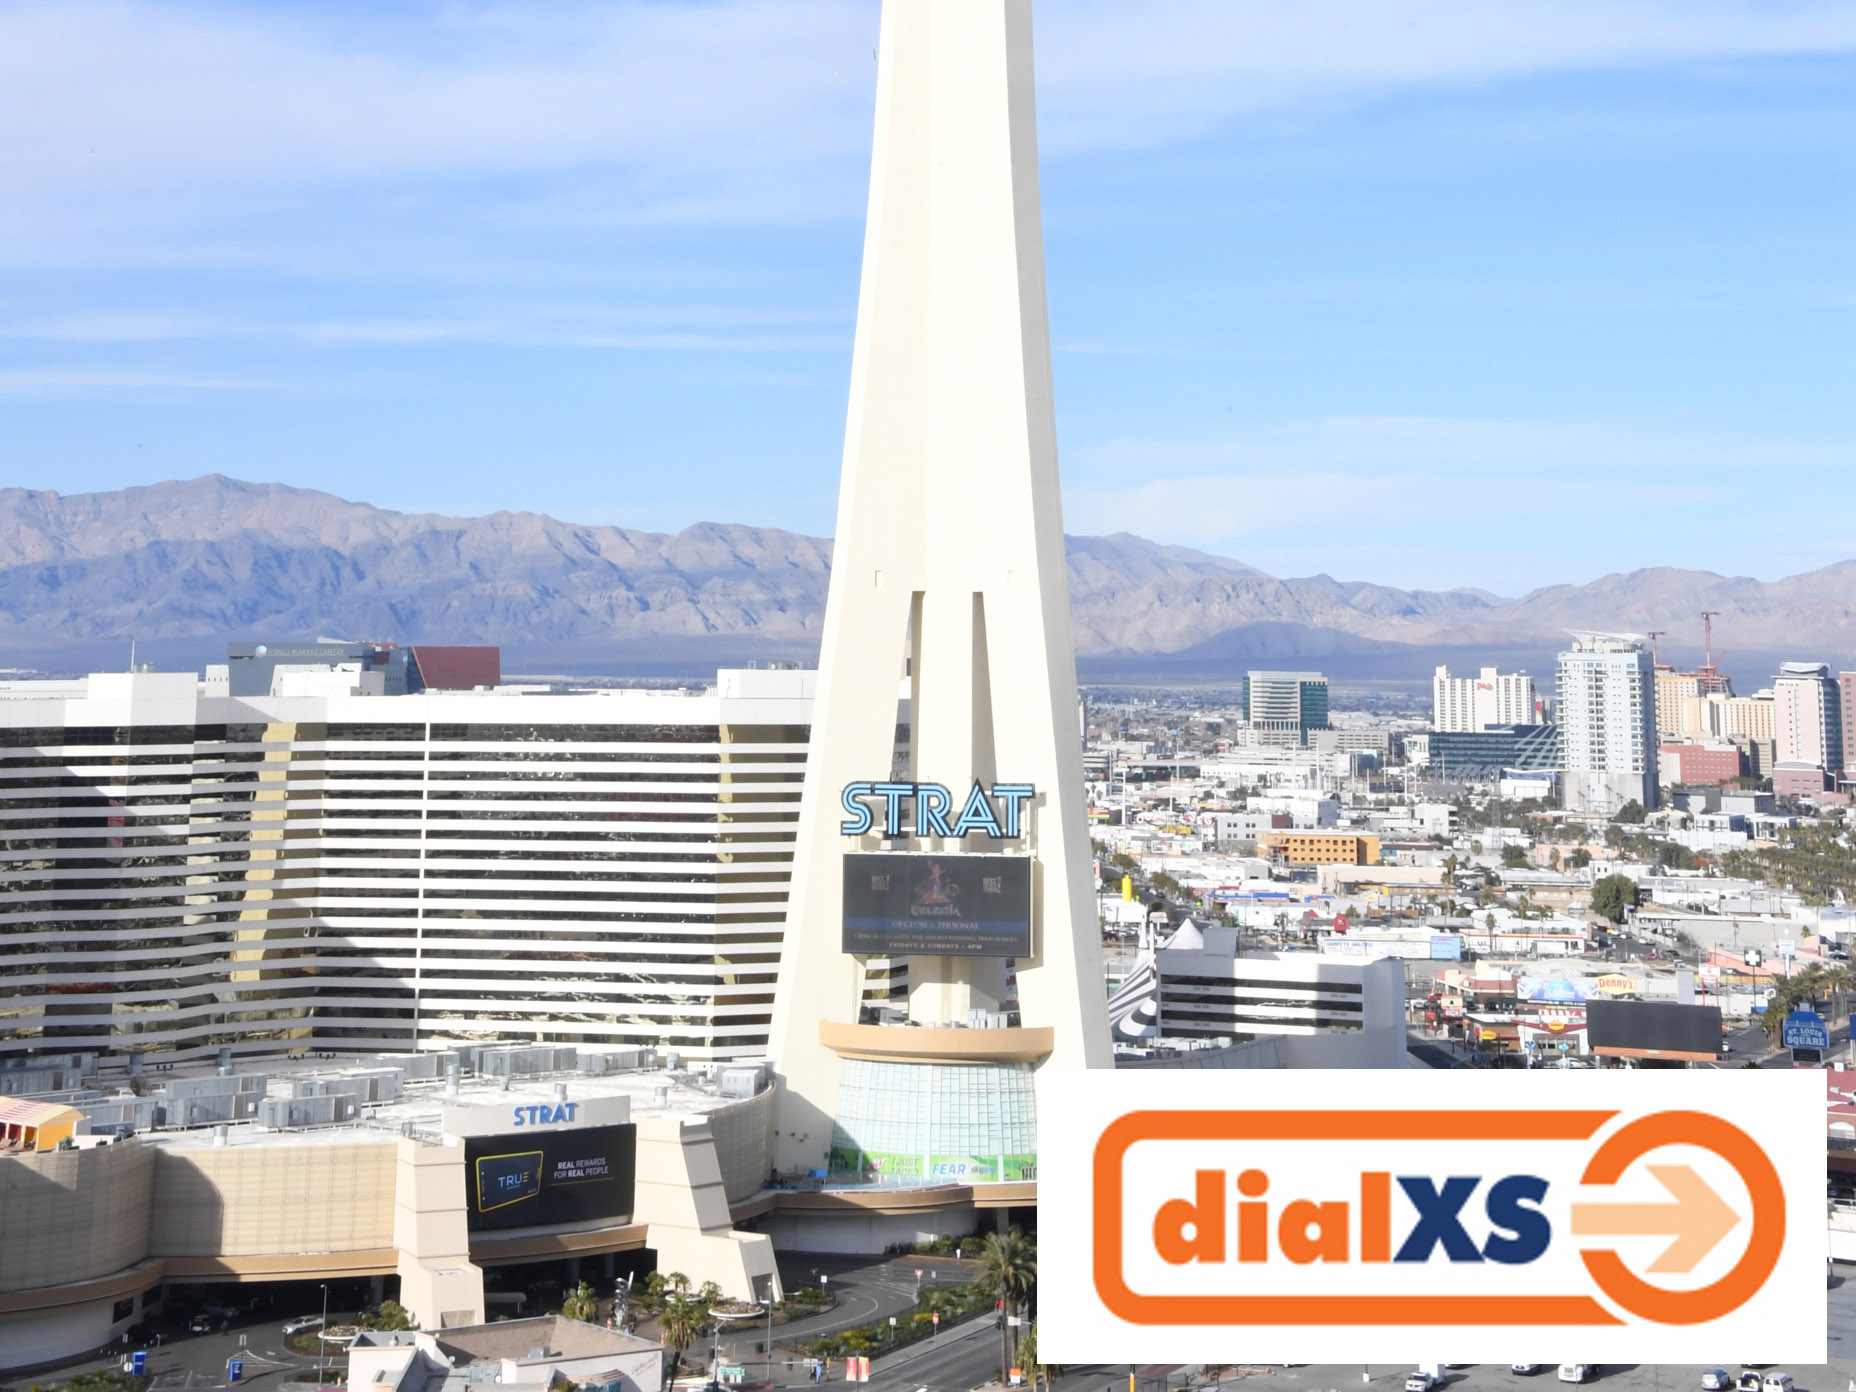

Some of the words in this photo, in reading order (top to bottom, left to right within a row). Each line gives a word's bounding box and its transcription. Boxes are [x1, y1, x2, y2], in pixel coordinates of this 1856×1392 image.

[841, 778, 1034, 838] STRAT
[938, 921, 979, 929] PERSONAL
[1598, 978, 1633, 989] Denny's
[1800, 1027, 1823, 1037] LOUIS
[1786, 1036, 1825, 1046] SQUARE
[513, 1102, 578, 1126] STRAT
[557, 1161, 575, 1170] REAL
[575, 1157, 606, 1168] REWARDS
[896, 1158, 919, 1167] JUST
[554, 1170, 568, 1179] FOR
[568, 1168, 585, 1178] REAL
[585, 1166, 609, 1176] PEOPLE
[932, 1163, 967, 1176] FEAR
[498, 1171, 529, 1188] TRUE
